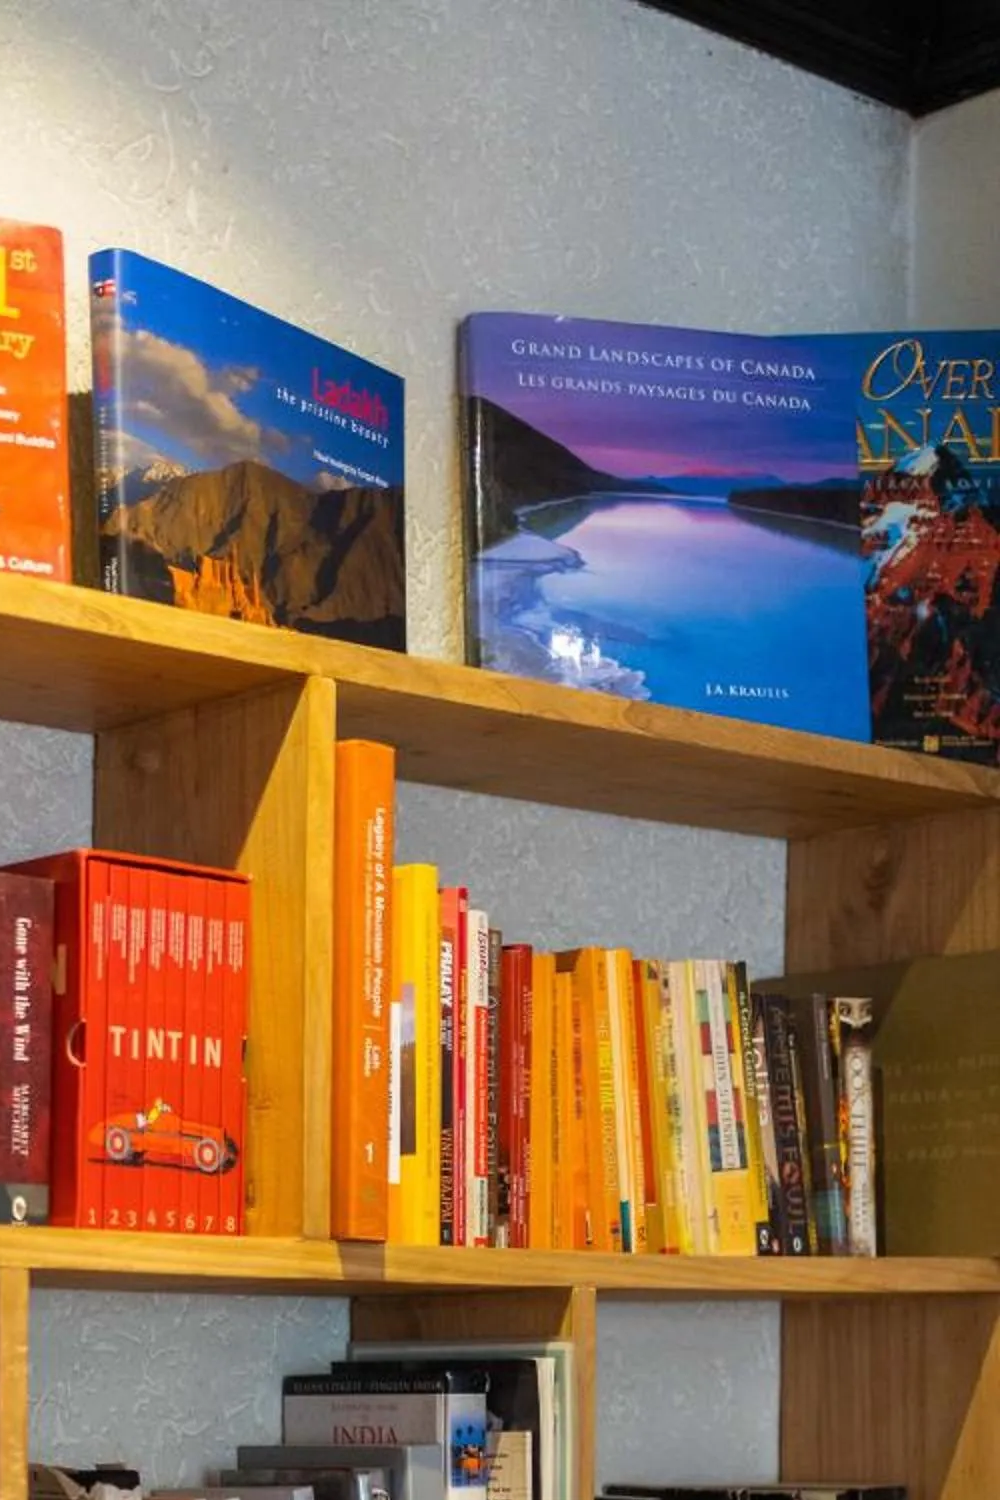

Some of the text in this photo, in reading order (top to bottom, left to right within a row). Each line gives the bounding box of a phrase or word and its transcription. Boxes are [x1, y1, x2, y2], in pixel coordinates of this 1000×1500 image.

[511, 338, 816, 382] GRAND LANDSCAPES OF CANADA
[861, 338, 997, 404] OVER
[275, 386, 297, 406] the
[311, 367, 390, 433] Ladakh
[517, 372, 812, 412] LES GRANDS PAYSAGES DU CANADA
[369, 807, 387, 1018] Legacy of A Mountain People
[439, 941, 455, 1009] PRALAY
[13, 917, 32, 1062] Gone with the Wind
[109, 1025, 223, 1069] TINTIN
[87, 1207, 97, 1225] 1
[109, 1208, 120, 1226] 2
[126, 1209, 138, 1227] 3
[146, 1208, 157, 1226] 4
[166, 1209, 177, 1226] 5
[185, 1212, 196, 1230] 6
[204, 1214, 214, 1231] 7
[224, 1216, 236, 1233] 8
[332, 1425, 399, 1445] INDIA
